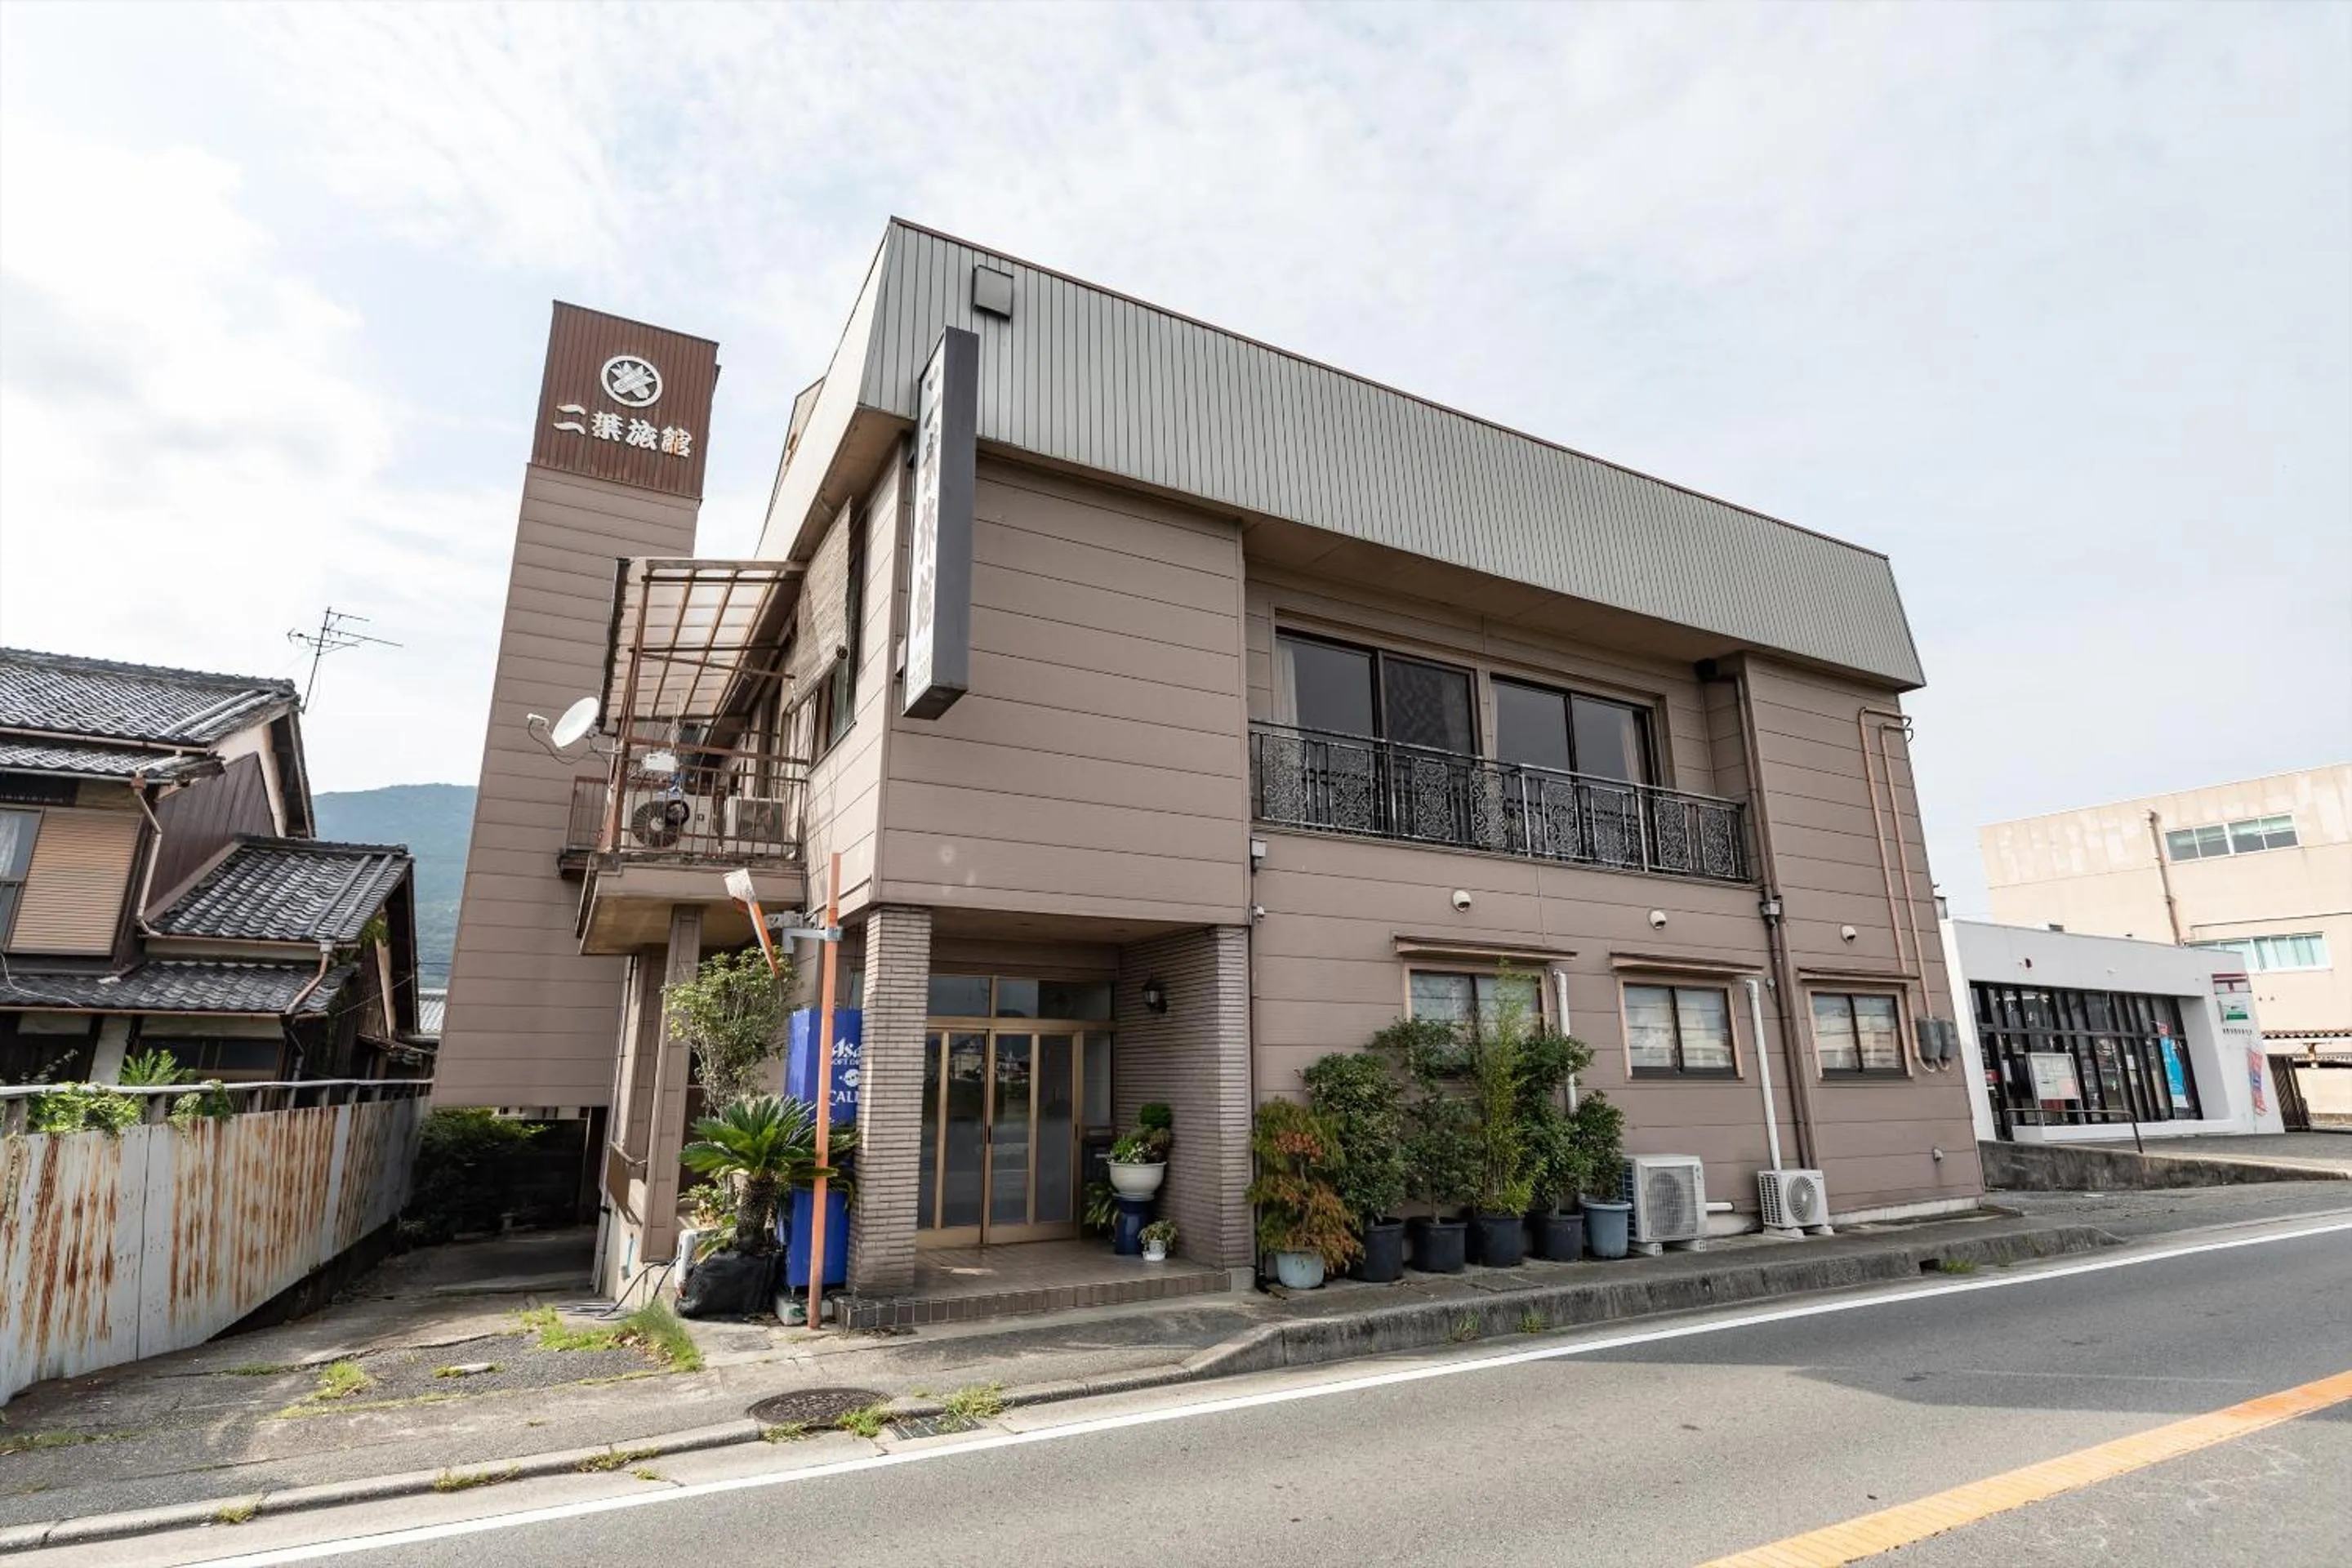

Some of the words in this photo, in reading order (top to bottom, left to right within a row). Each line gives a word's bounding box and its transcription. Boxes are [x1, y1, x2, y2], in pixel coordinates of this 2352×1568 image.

[554, 403, 693, 457] 二葉旅館
[831, 1037, 862, 1058] Asa
[829, 1089, 860, 1107] CAL
